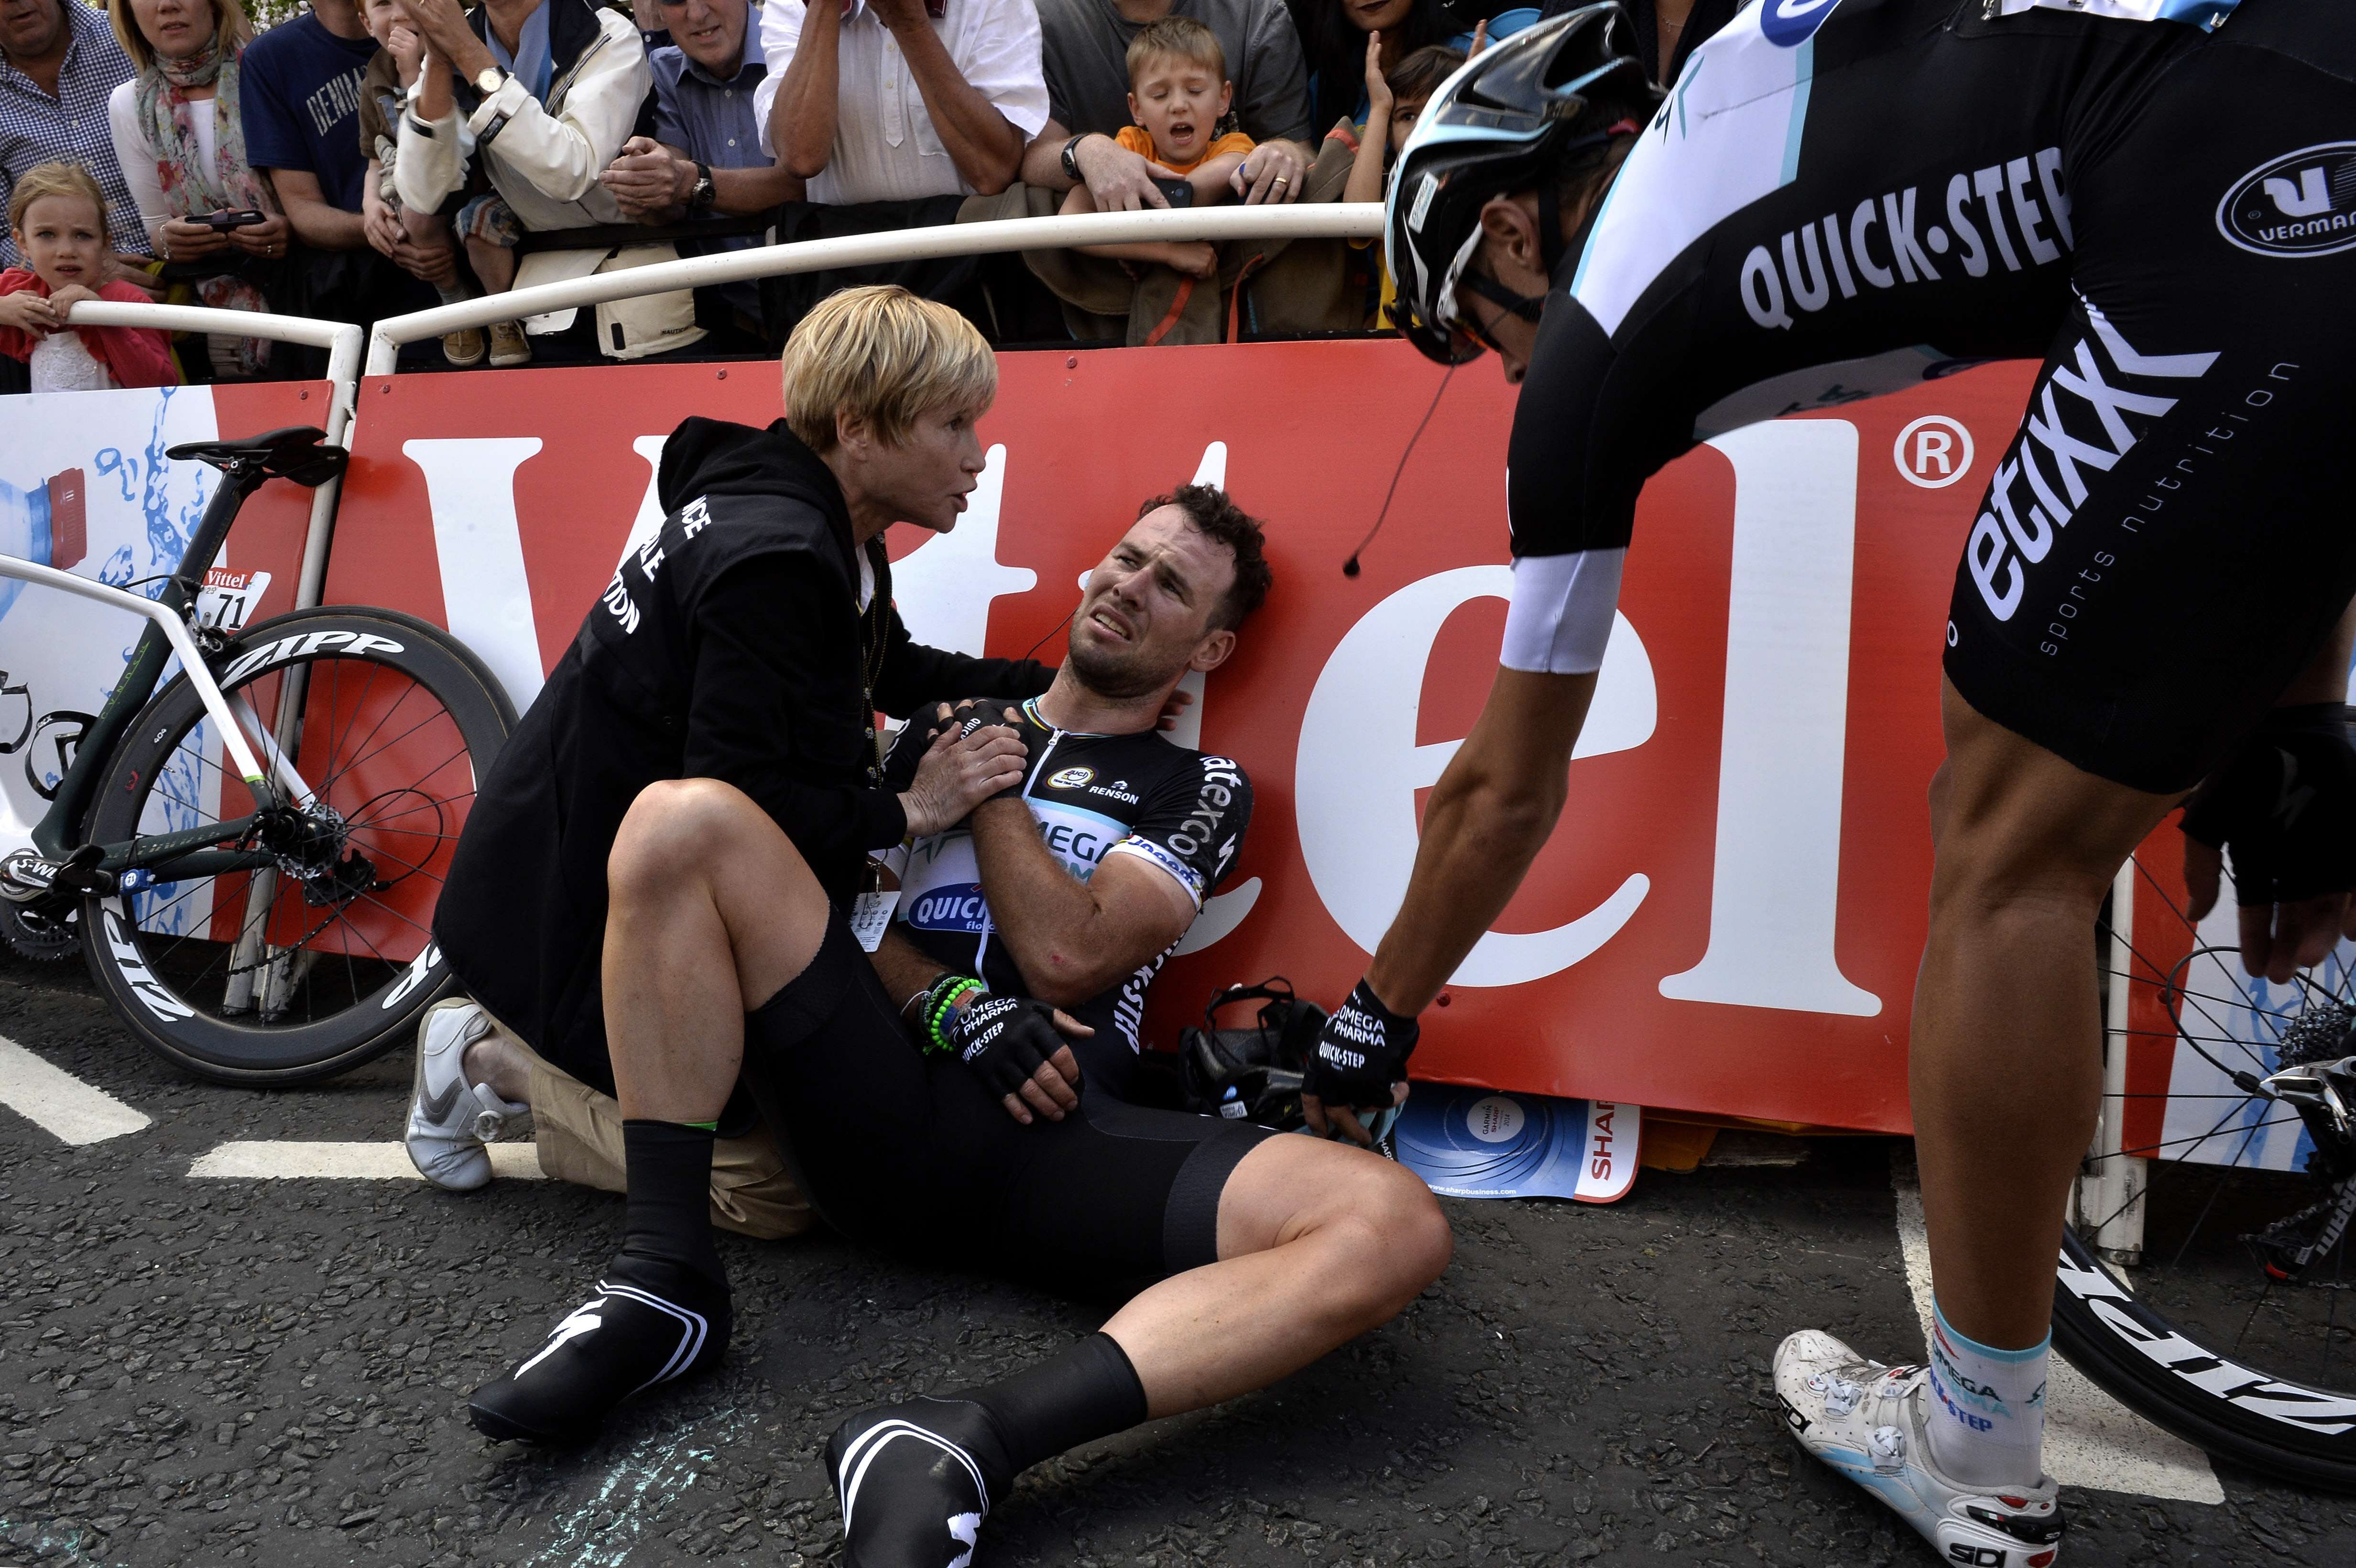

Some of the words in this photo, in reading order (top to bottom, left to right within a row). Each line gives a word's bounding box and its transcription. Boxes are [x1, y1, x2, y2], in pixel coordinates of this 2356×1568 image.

[2040, 551, 2115, 656] sports
[2121, 362, 2300, 532] nutrition
[207, 570, 246, 588] Vittel
[214, 594, 246, 629] 71
[219, 631, 405, 691] ZIPP
[1088, 785, 1139, 805] RENSON
[963, 1003, 1018, 1036] PHARMA
[1334, 1020, 1385, 1047] PHARMA
[1339, 1004, 1385, 1034] OMEGA
[1483, 1105, 1492, 1135] GARMIN
[1491, 1107, 1500, 1132] SHARP
